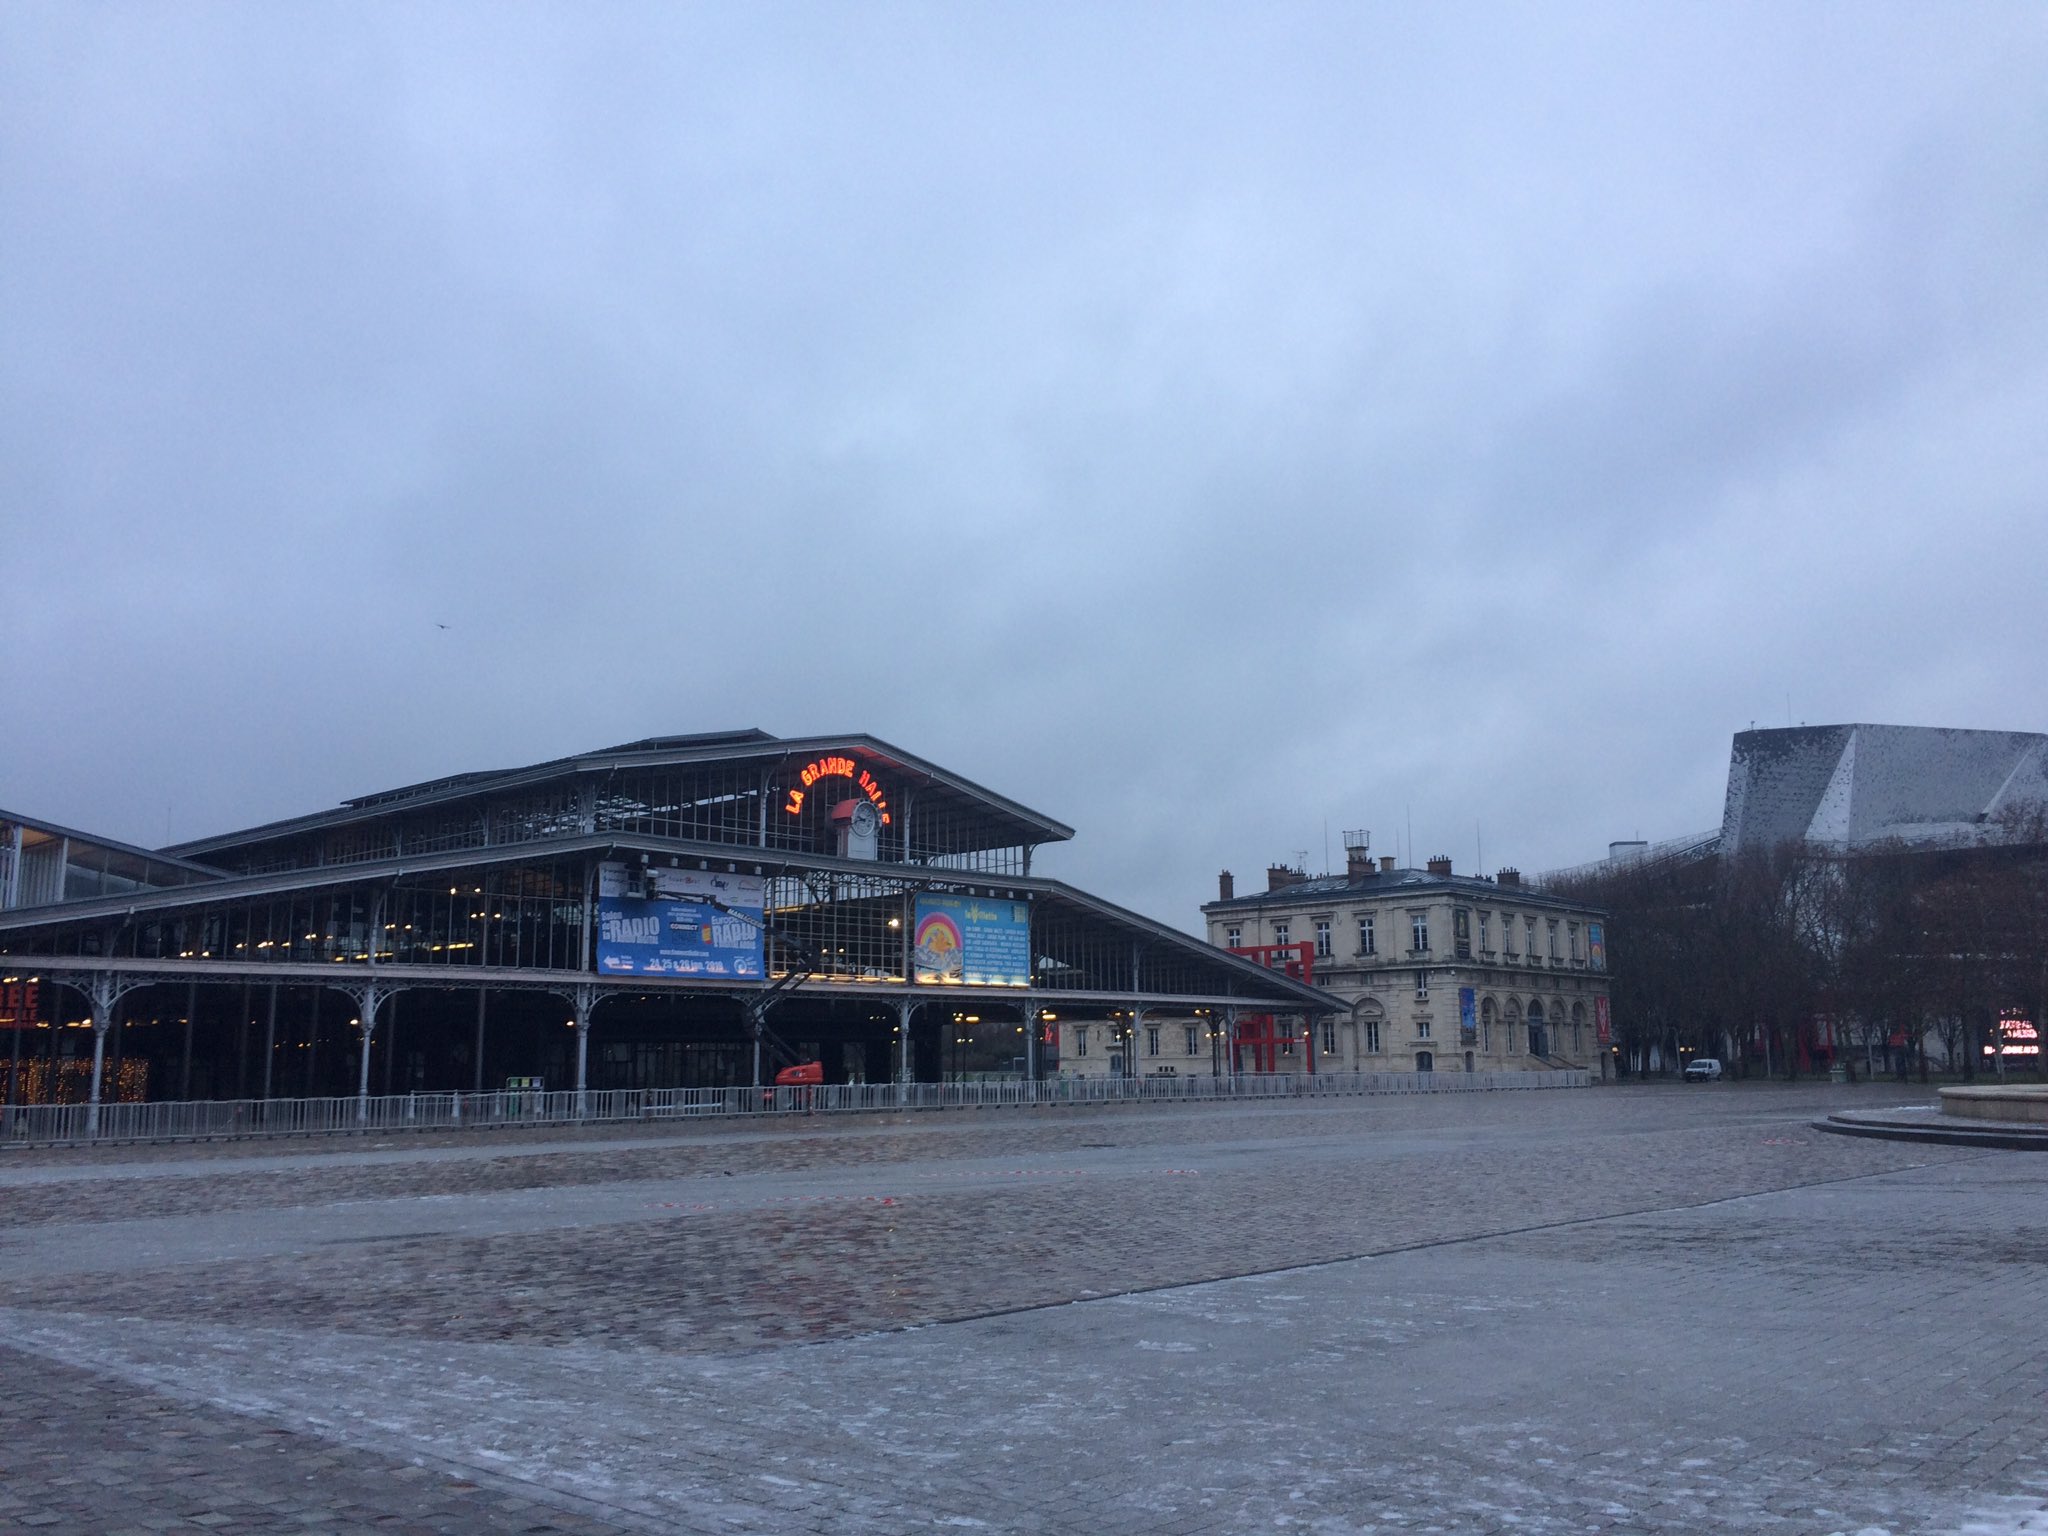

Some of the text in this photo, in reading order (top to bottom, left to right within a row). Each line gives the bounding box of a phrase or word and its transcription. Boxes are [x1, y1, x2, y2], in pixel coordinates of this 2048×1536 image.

[785, 789, 805, 815] LA
[801, 757, 856, 786] GRANDE
[610, 916, 660, 943] RADIO
